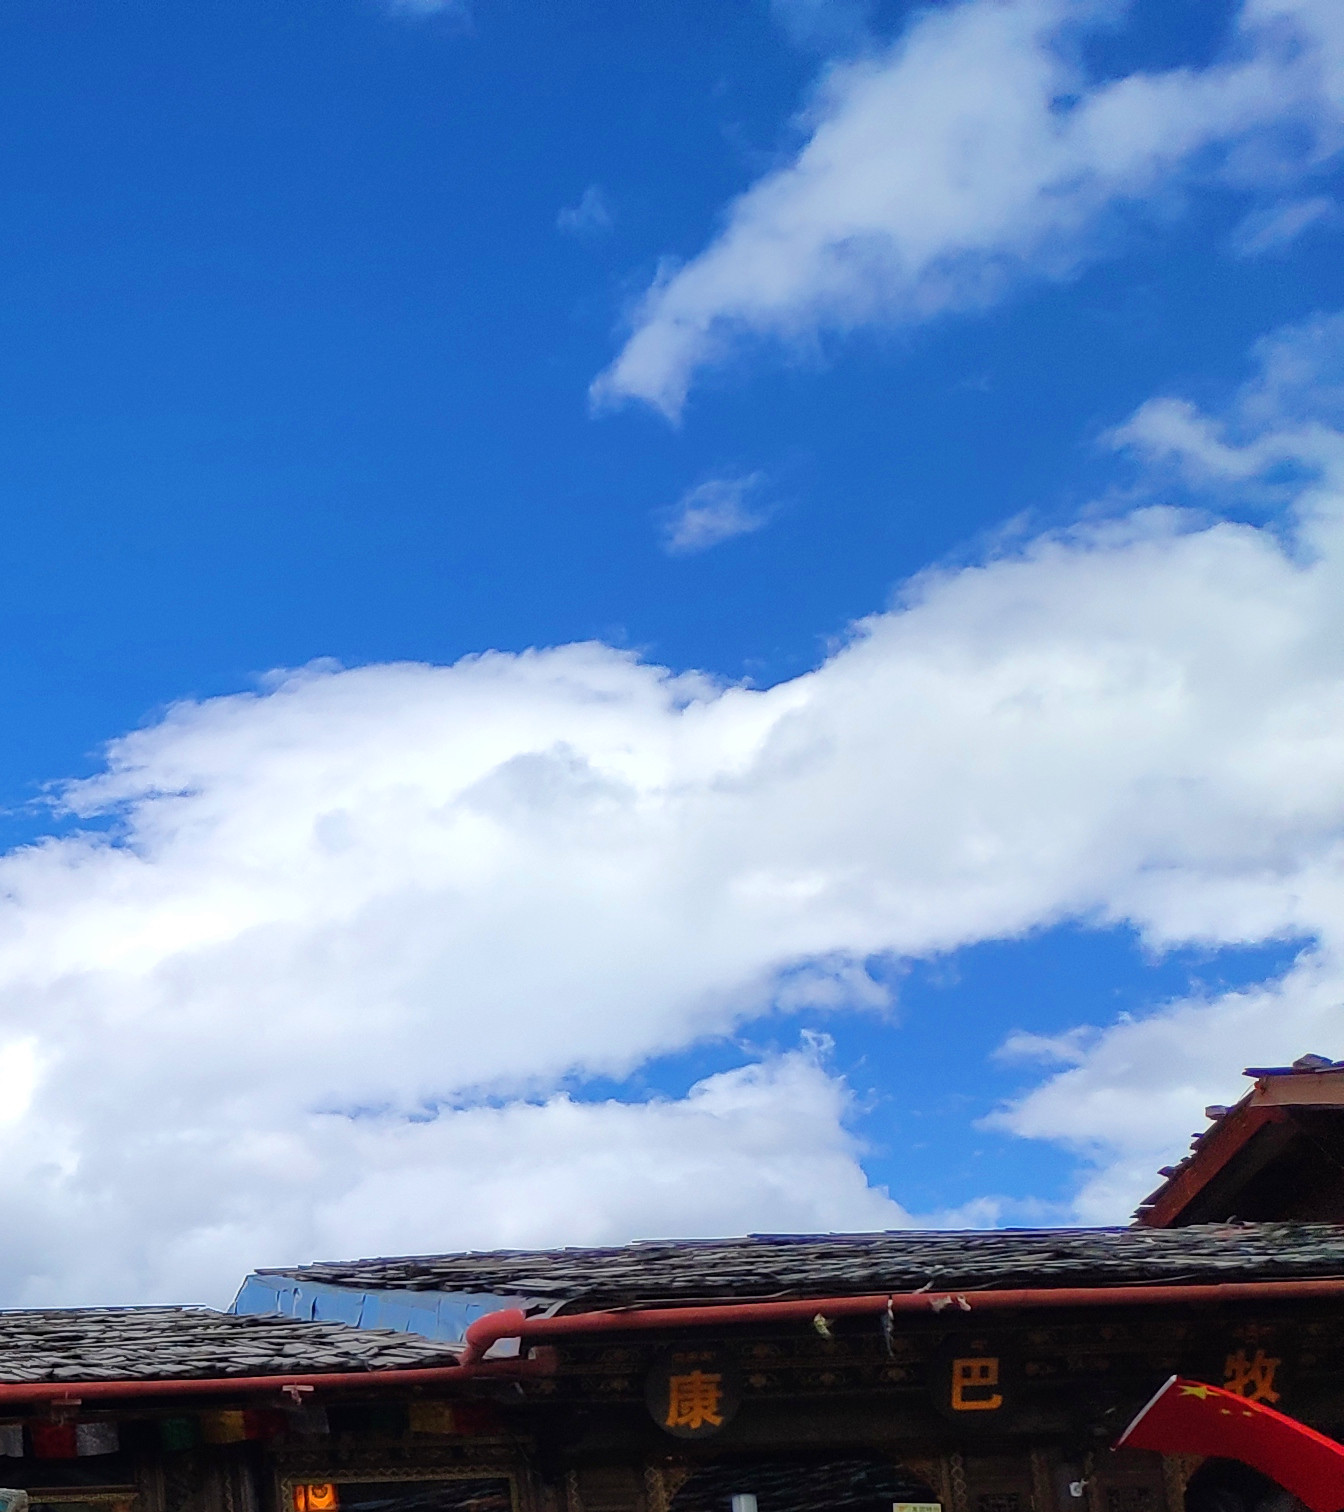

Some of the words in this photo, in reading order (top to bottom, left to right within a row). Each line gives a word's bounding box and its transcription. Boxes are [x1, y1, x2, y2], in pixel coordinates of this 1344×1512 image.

[665, 1370, 723, 1430] 康
[951, 1356, 1004, 1412] 巴
[1223, 1349, 1283, 1406] 牧
